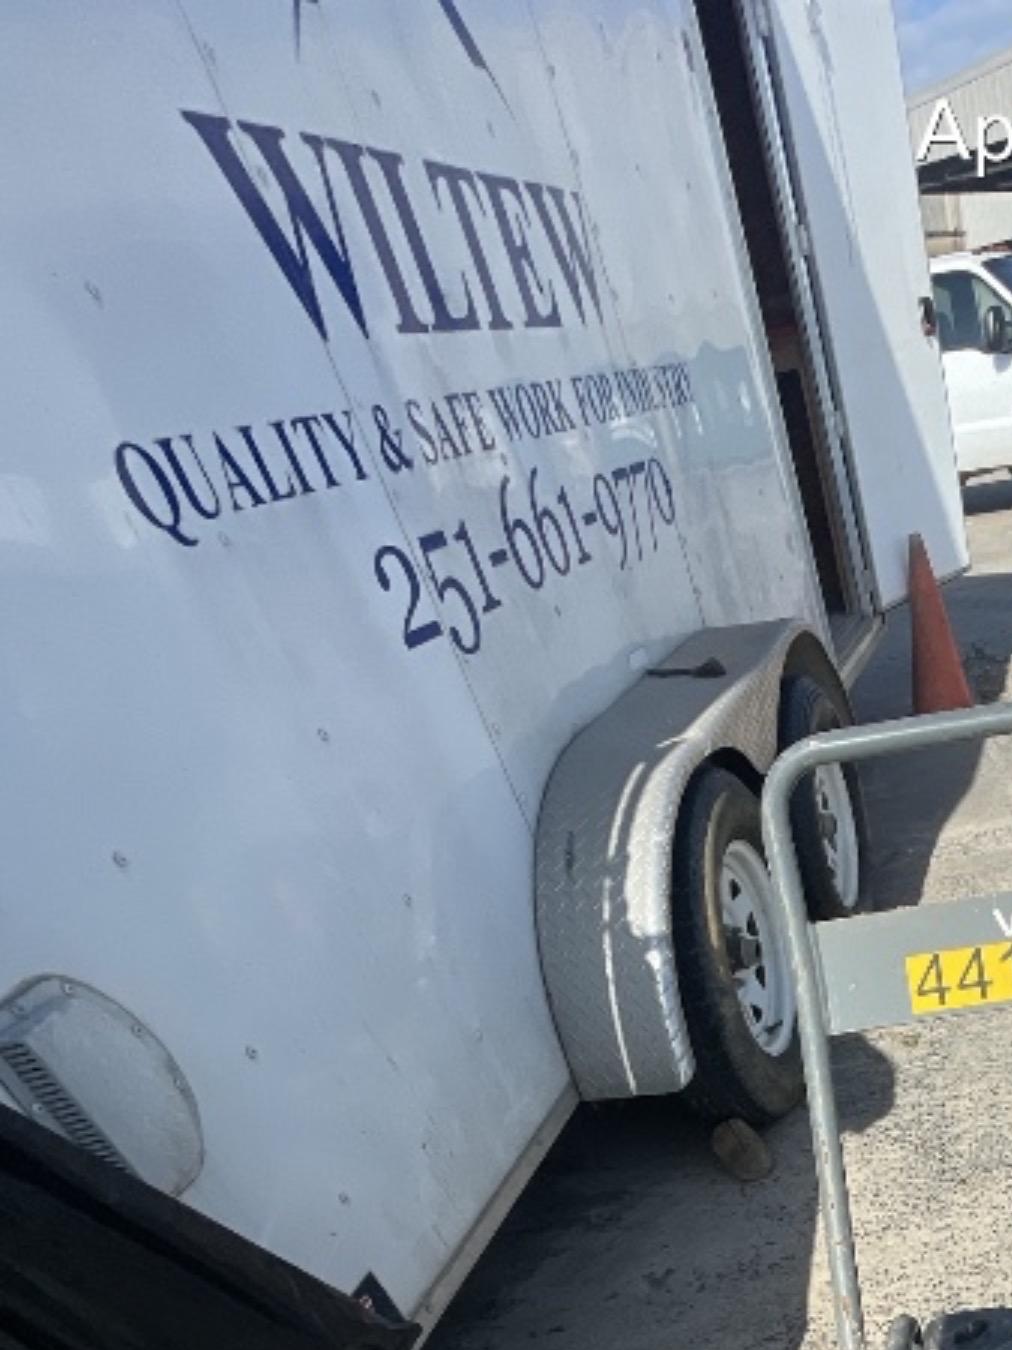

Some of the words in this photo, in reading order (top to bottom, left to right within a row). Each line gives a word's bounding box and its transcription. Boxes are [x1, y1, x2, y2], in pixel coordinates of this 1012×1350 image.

[178, 109, 604, 341] WILTEW
[114, 409, 368, 547] QUALITY
[371, 404, 414, 473] &
[405, 390, 496, 465] SAFE
[487, 378, 576, 441] WORK
[570, 374, 618, 426] FOR
[374, 458, 676, 654] 251-661-9770
